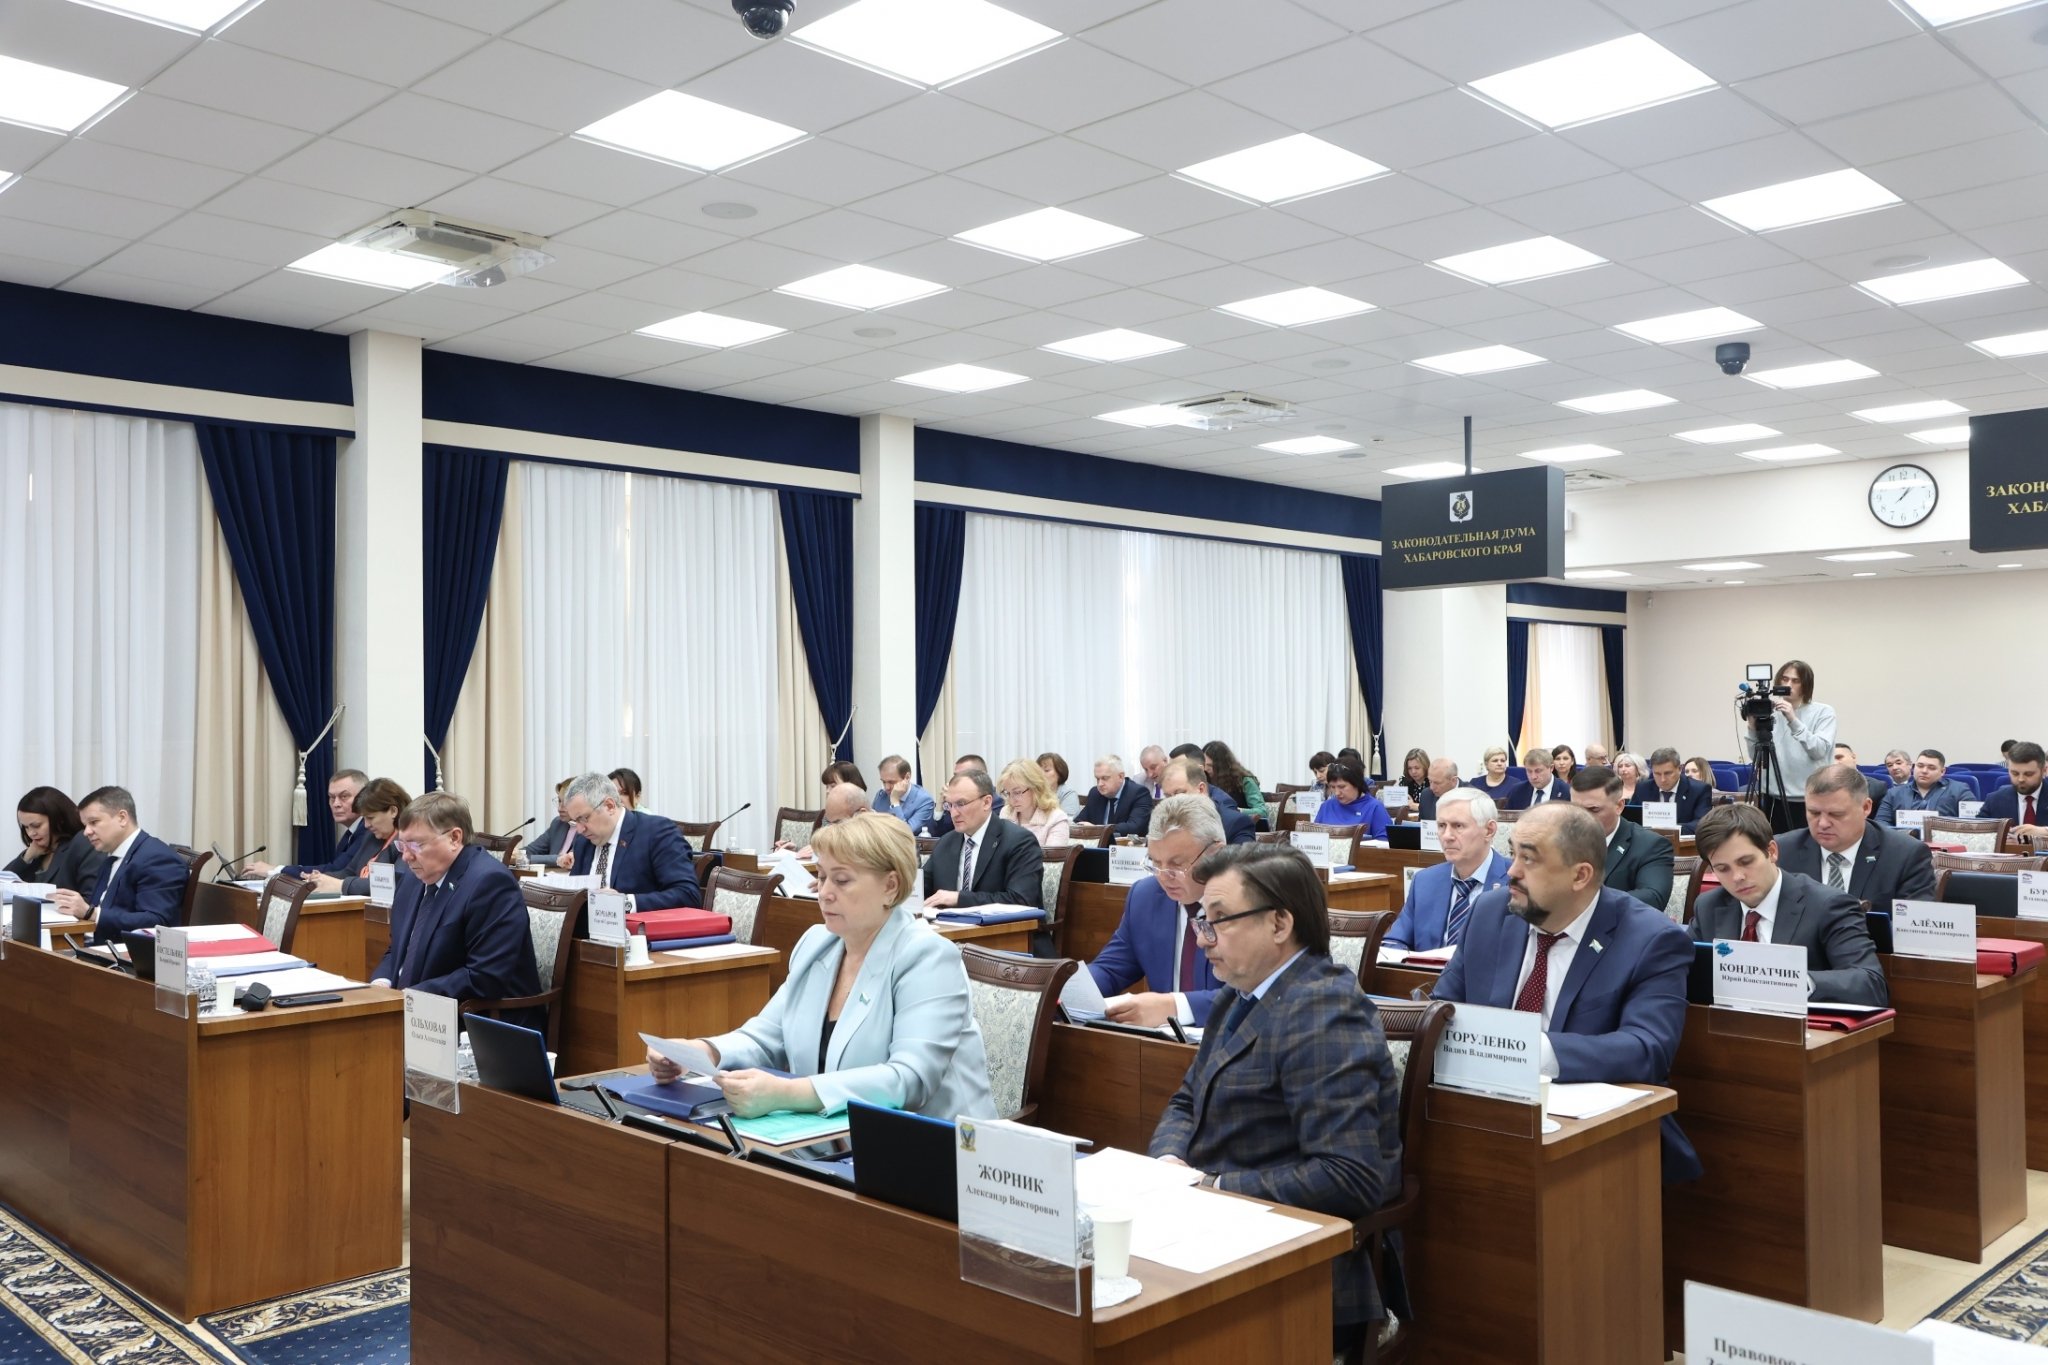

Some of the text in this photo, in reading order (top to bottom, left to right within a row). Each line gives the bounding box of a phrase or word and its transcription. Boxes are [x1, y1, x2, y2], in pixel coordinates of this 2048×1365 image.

[1986, 481, 2048, 497] ЗАКОН
[1391, 526, 1536, 550] ЗАКОНОДАТЕЛЬНАЯ ДУМА
[1403, 543, 1522, 563] ХАБАРОВСКОГО КРАЯ
[1911, 918, 1954, 930] АЛЁХИН
[1719, 963, 1800, 979] КОНДРАТЧИК
[1722, 974, 1798, 988] Юрий Константинович
[410, 1016, 447, 1035] ОЛЬХОВАЯ
[1445, 1029, 1527, 1052] ГОРУЛЕНКО
[1443, 1044, 1527, 1064] Вадим Владимирович
[978, 1164, 1044, 1194] ЖОРНИК
[965, 1184, 1060, 1217] Александр Викторович
